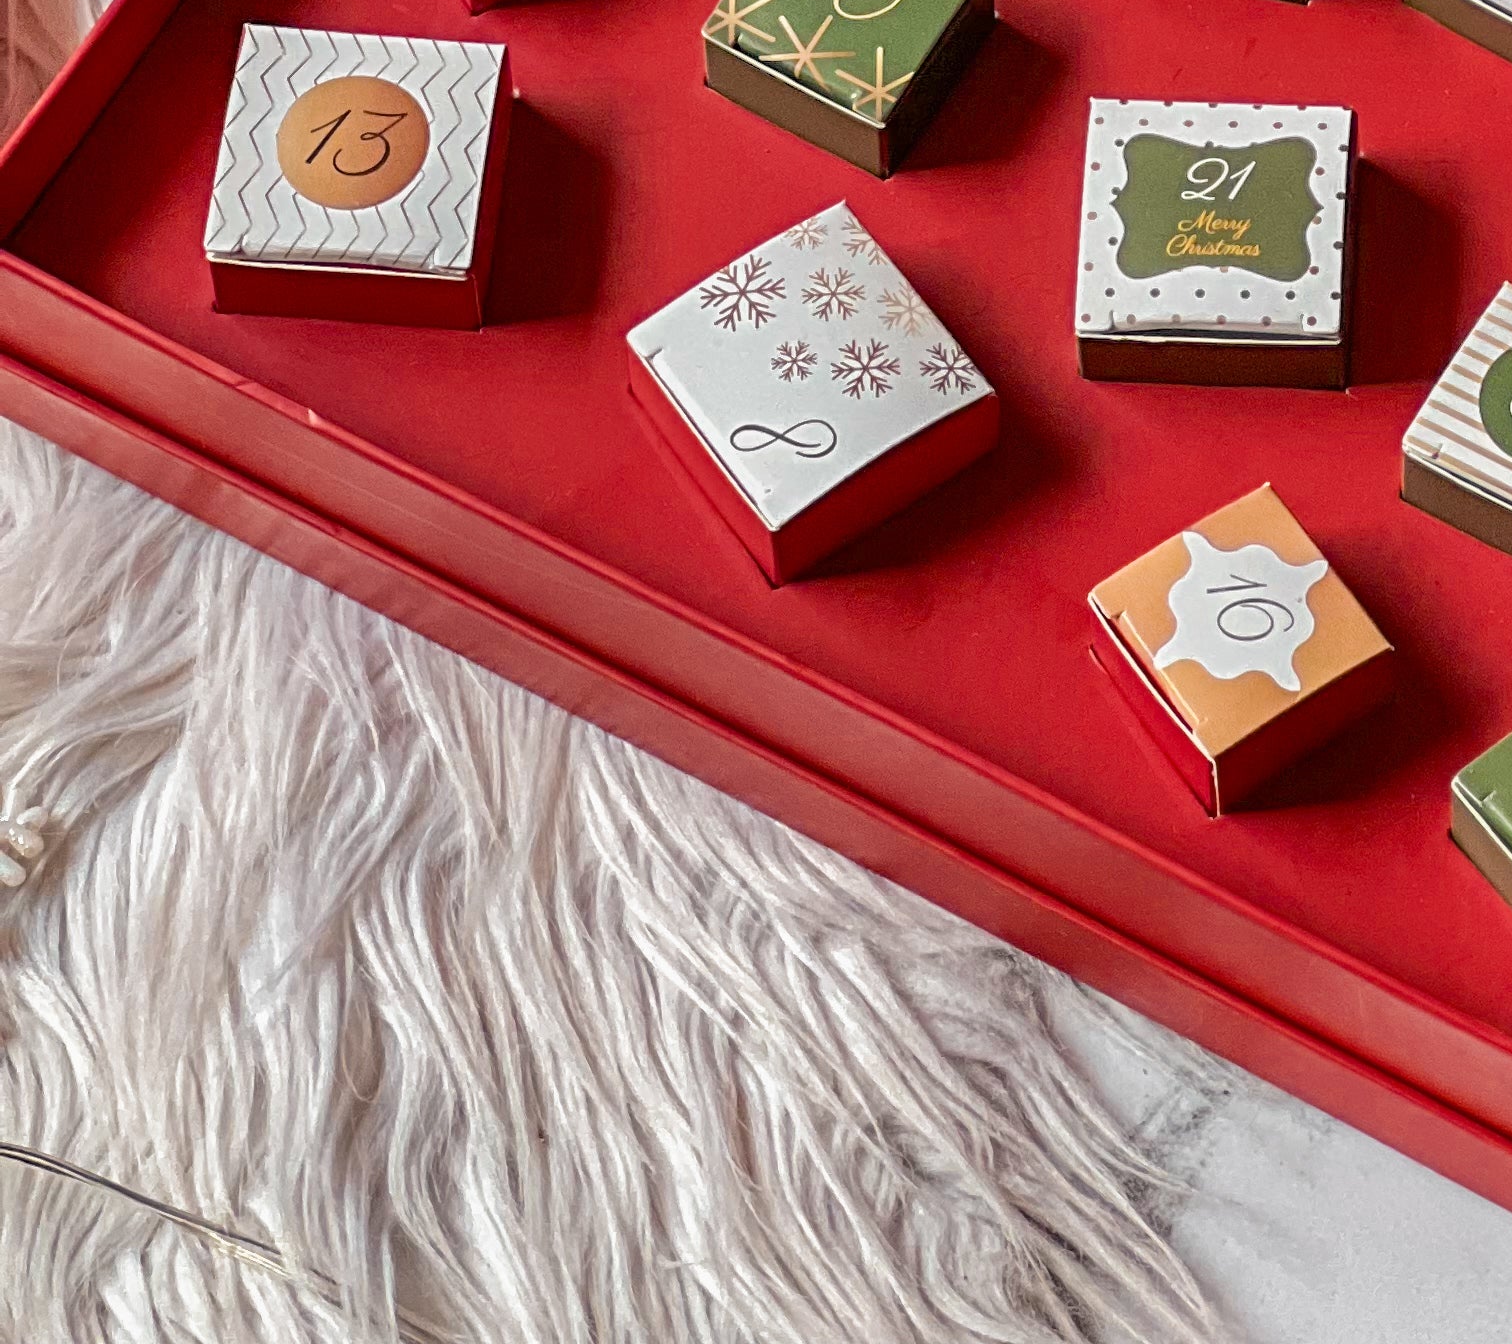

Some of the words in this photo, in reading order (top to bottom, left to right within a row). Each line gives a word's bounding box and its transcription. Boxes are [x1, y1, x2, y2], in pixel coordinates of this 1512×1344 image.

[305, 109, 408, 177] 13
[1182, 158, 1256, 201] 21
[1178, 210, 1251, 234] Merry
[1166, 231, 1260, 257] Christmas
[730, 419, 837, 458] 8
[1206, 574, 1294, 641] 16
